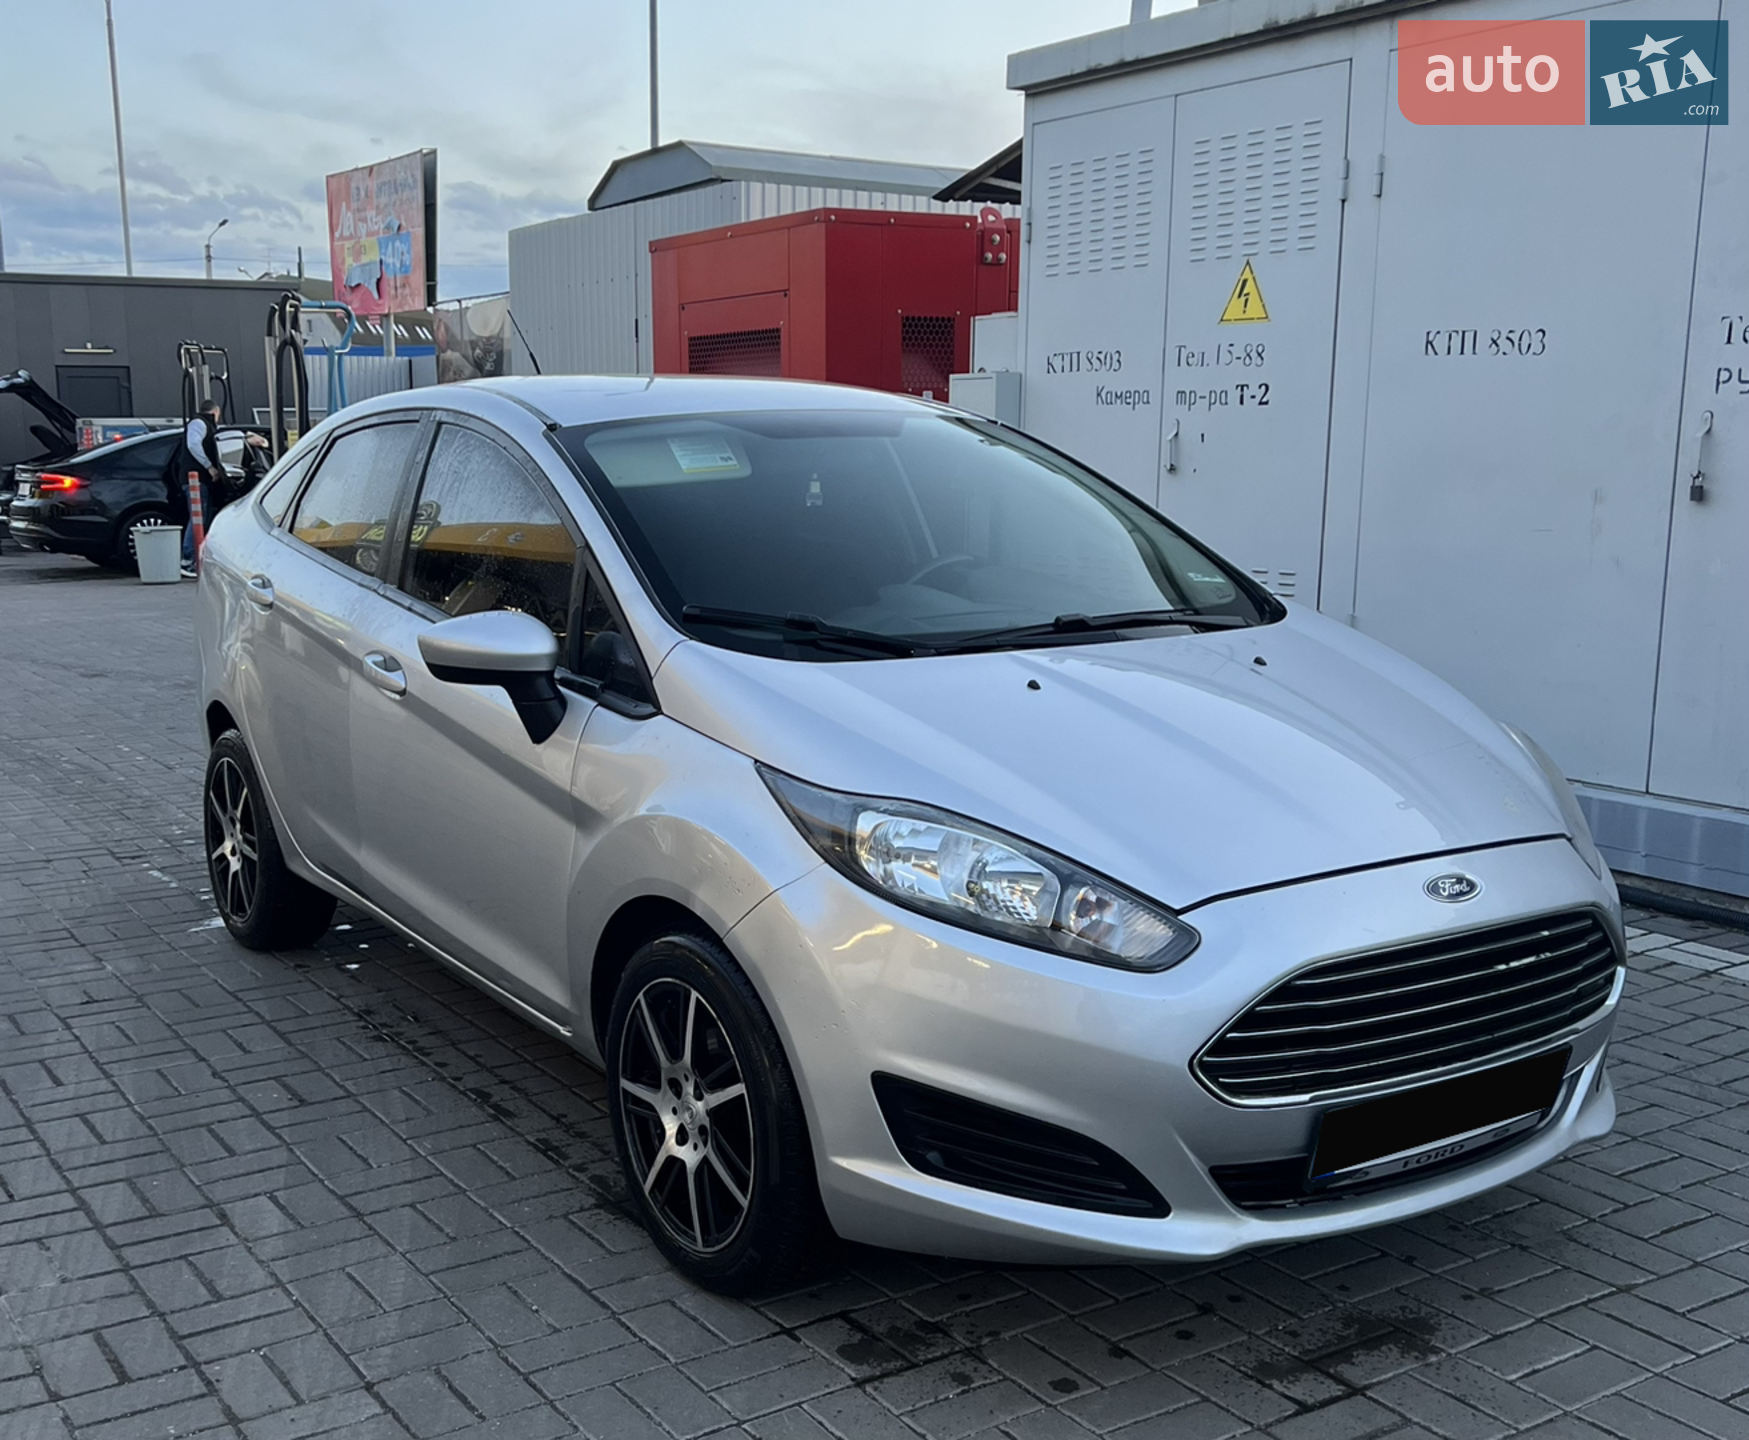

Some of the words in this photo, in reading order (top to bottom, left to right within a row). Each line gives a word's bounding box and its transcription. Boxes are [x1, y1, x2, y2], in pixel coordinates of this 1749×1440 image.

[1175, 344, 1210, 368] Тел.
[1215, 342, 1266, 368] 15-88
[1424, 329, 1479, 356] КТП
[1488, 328, 1547, 356] 8503
[1046, 352, 1081, 375] КТП
[1085, 350, 1123, 373] 8503
[1095, 385, 1151, 411] Камера
[1235, 382, 1270, 406] Т-2
[1438, 878, 1471, 896] Ford
[1402, 1143, 1466, 1170] FORD
